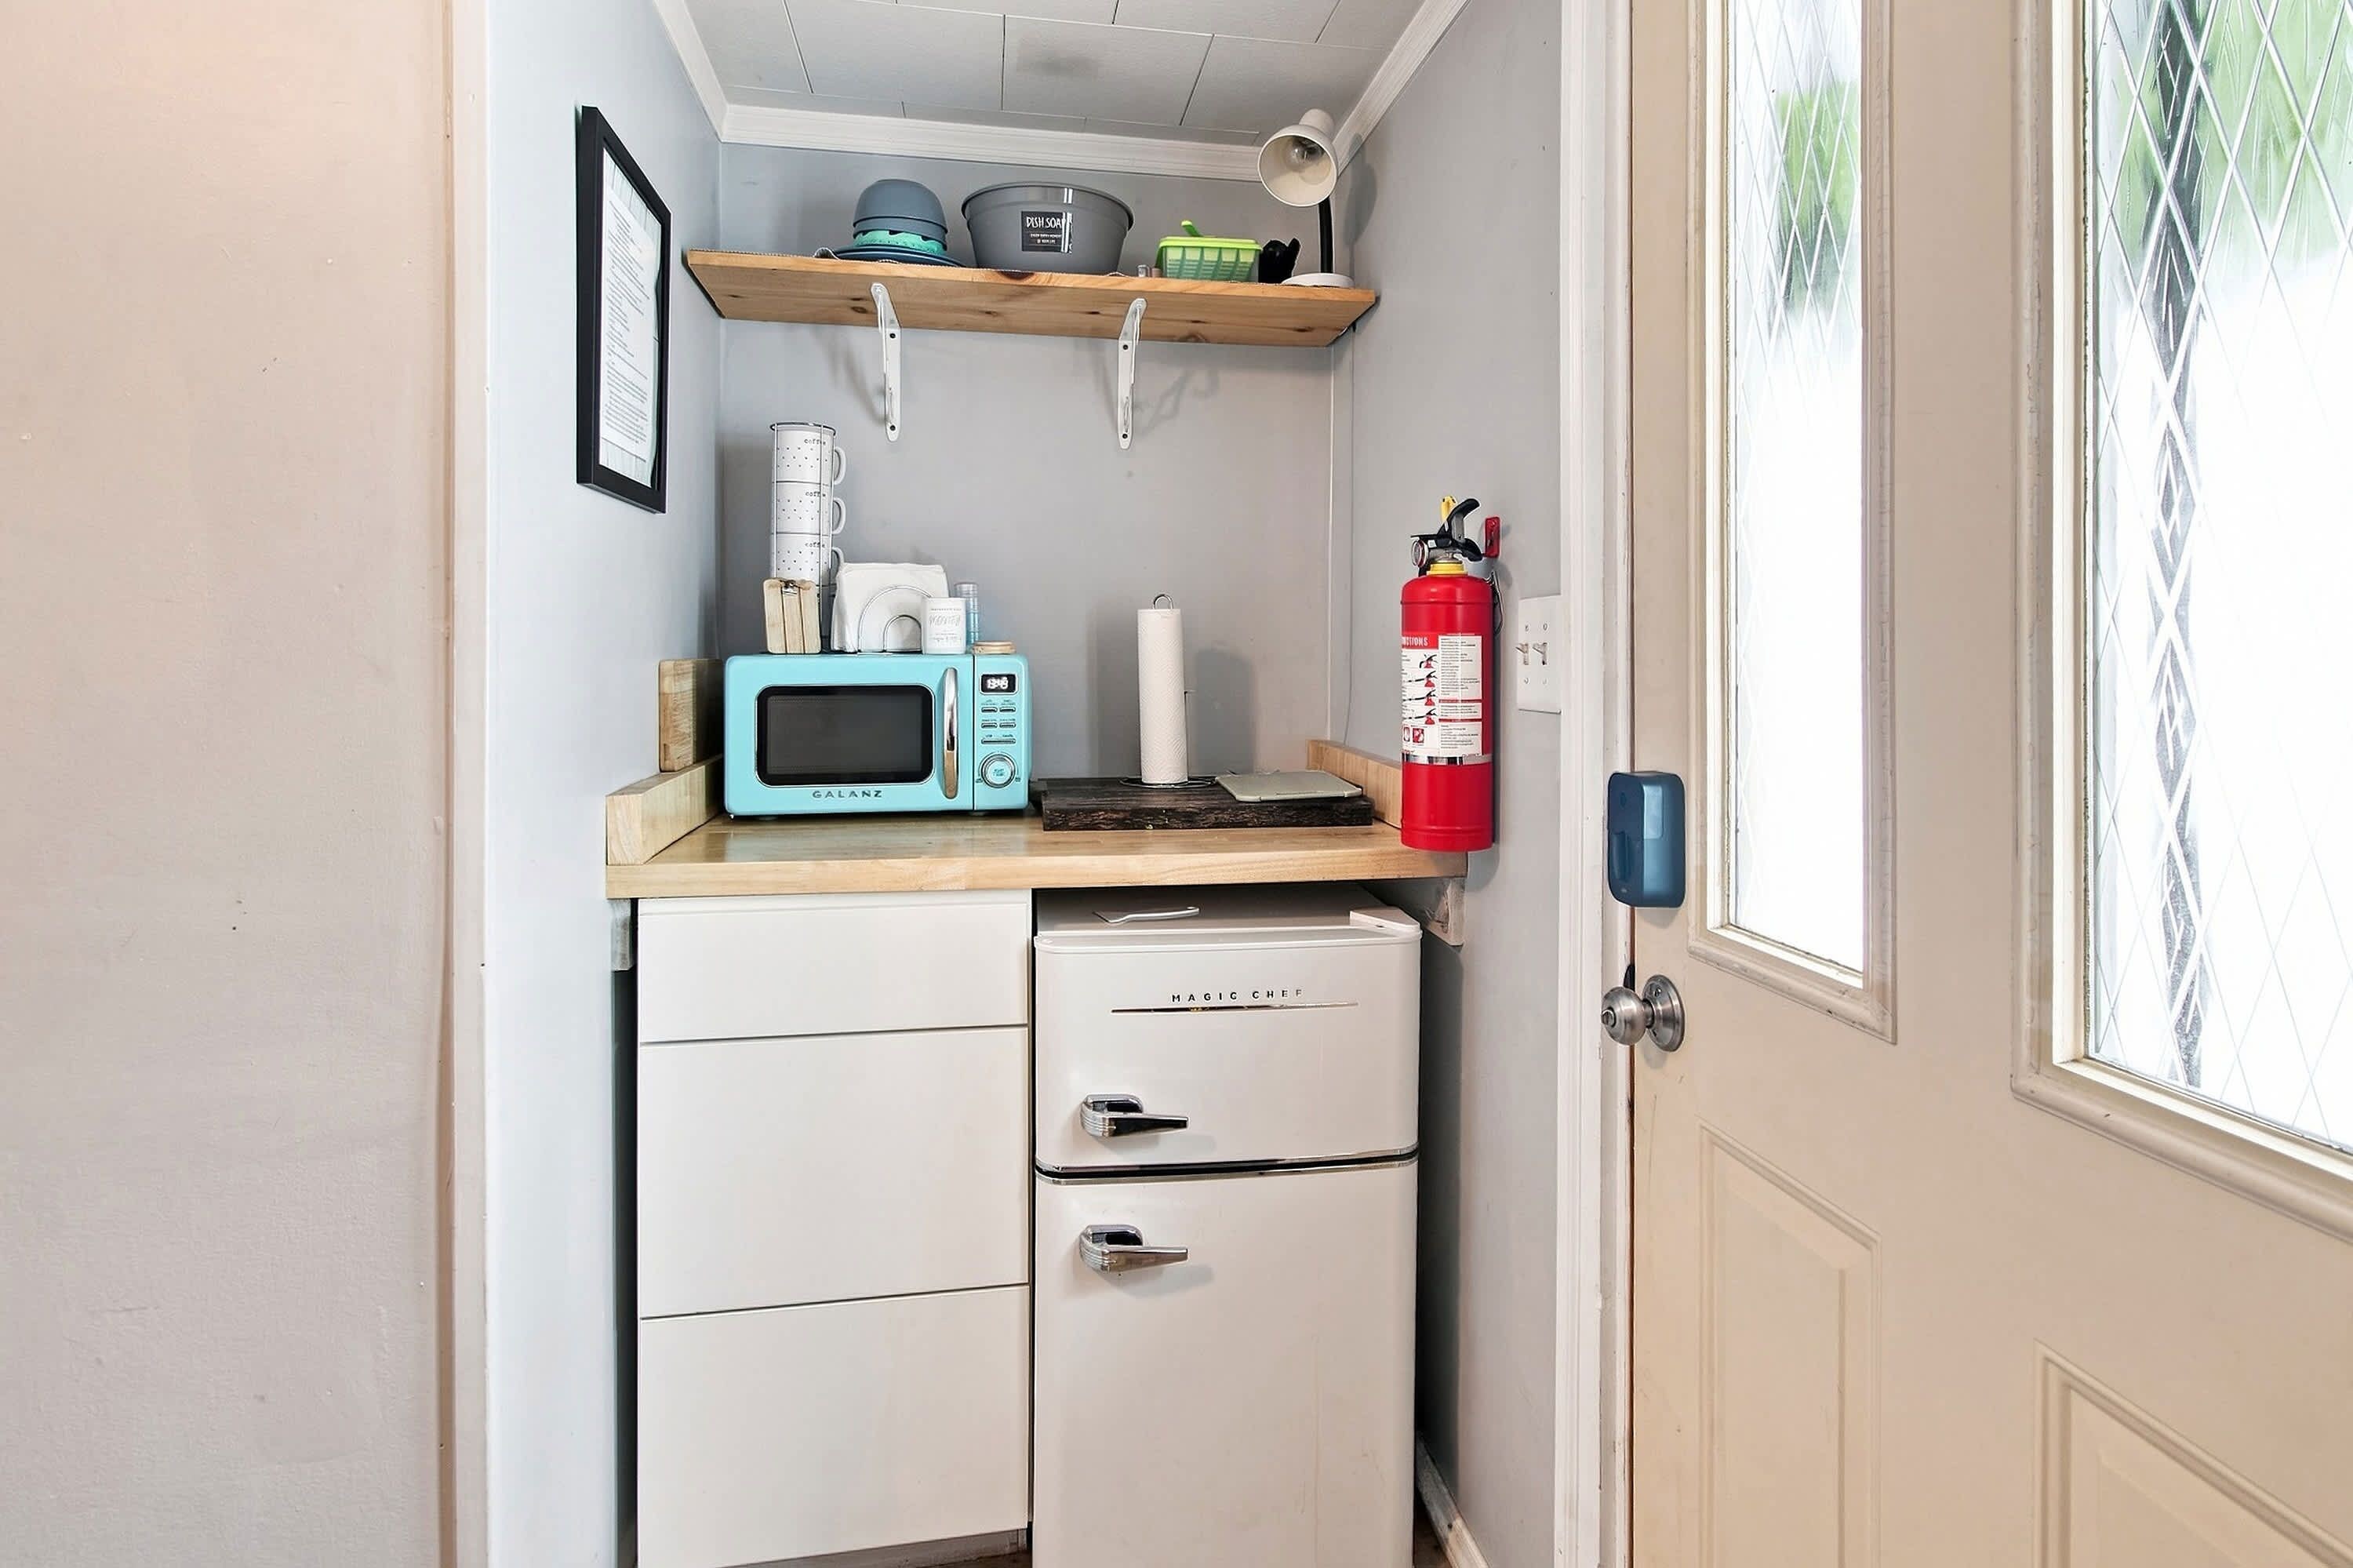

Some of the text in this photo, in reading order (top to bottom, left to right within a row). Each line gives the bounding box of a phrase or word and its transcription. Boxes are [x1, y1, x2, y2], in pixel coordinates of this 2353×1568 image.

[1026, 216, 1044, 227] DISH
[812, 790, 882, 799] GALANZ
[1172, 989, 1302, 1002] MAGIC CHEF
